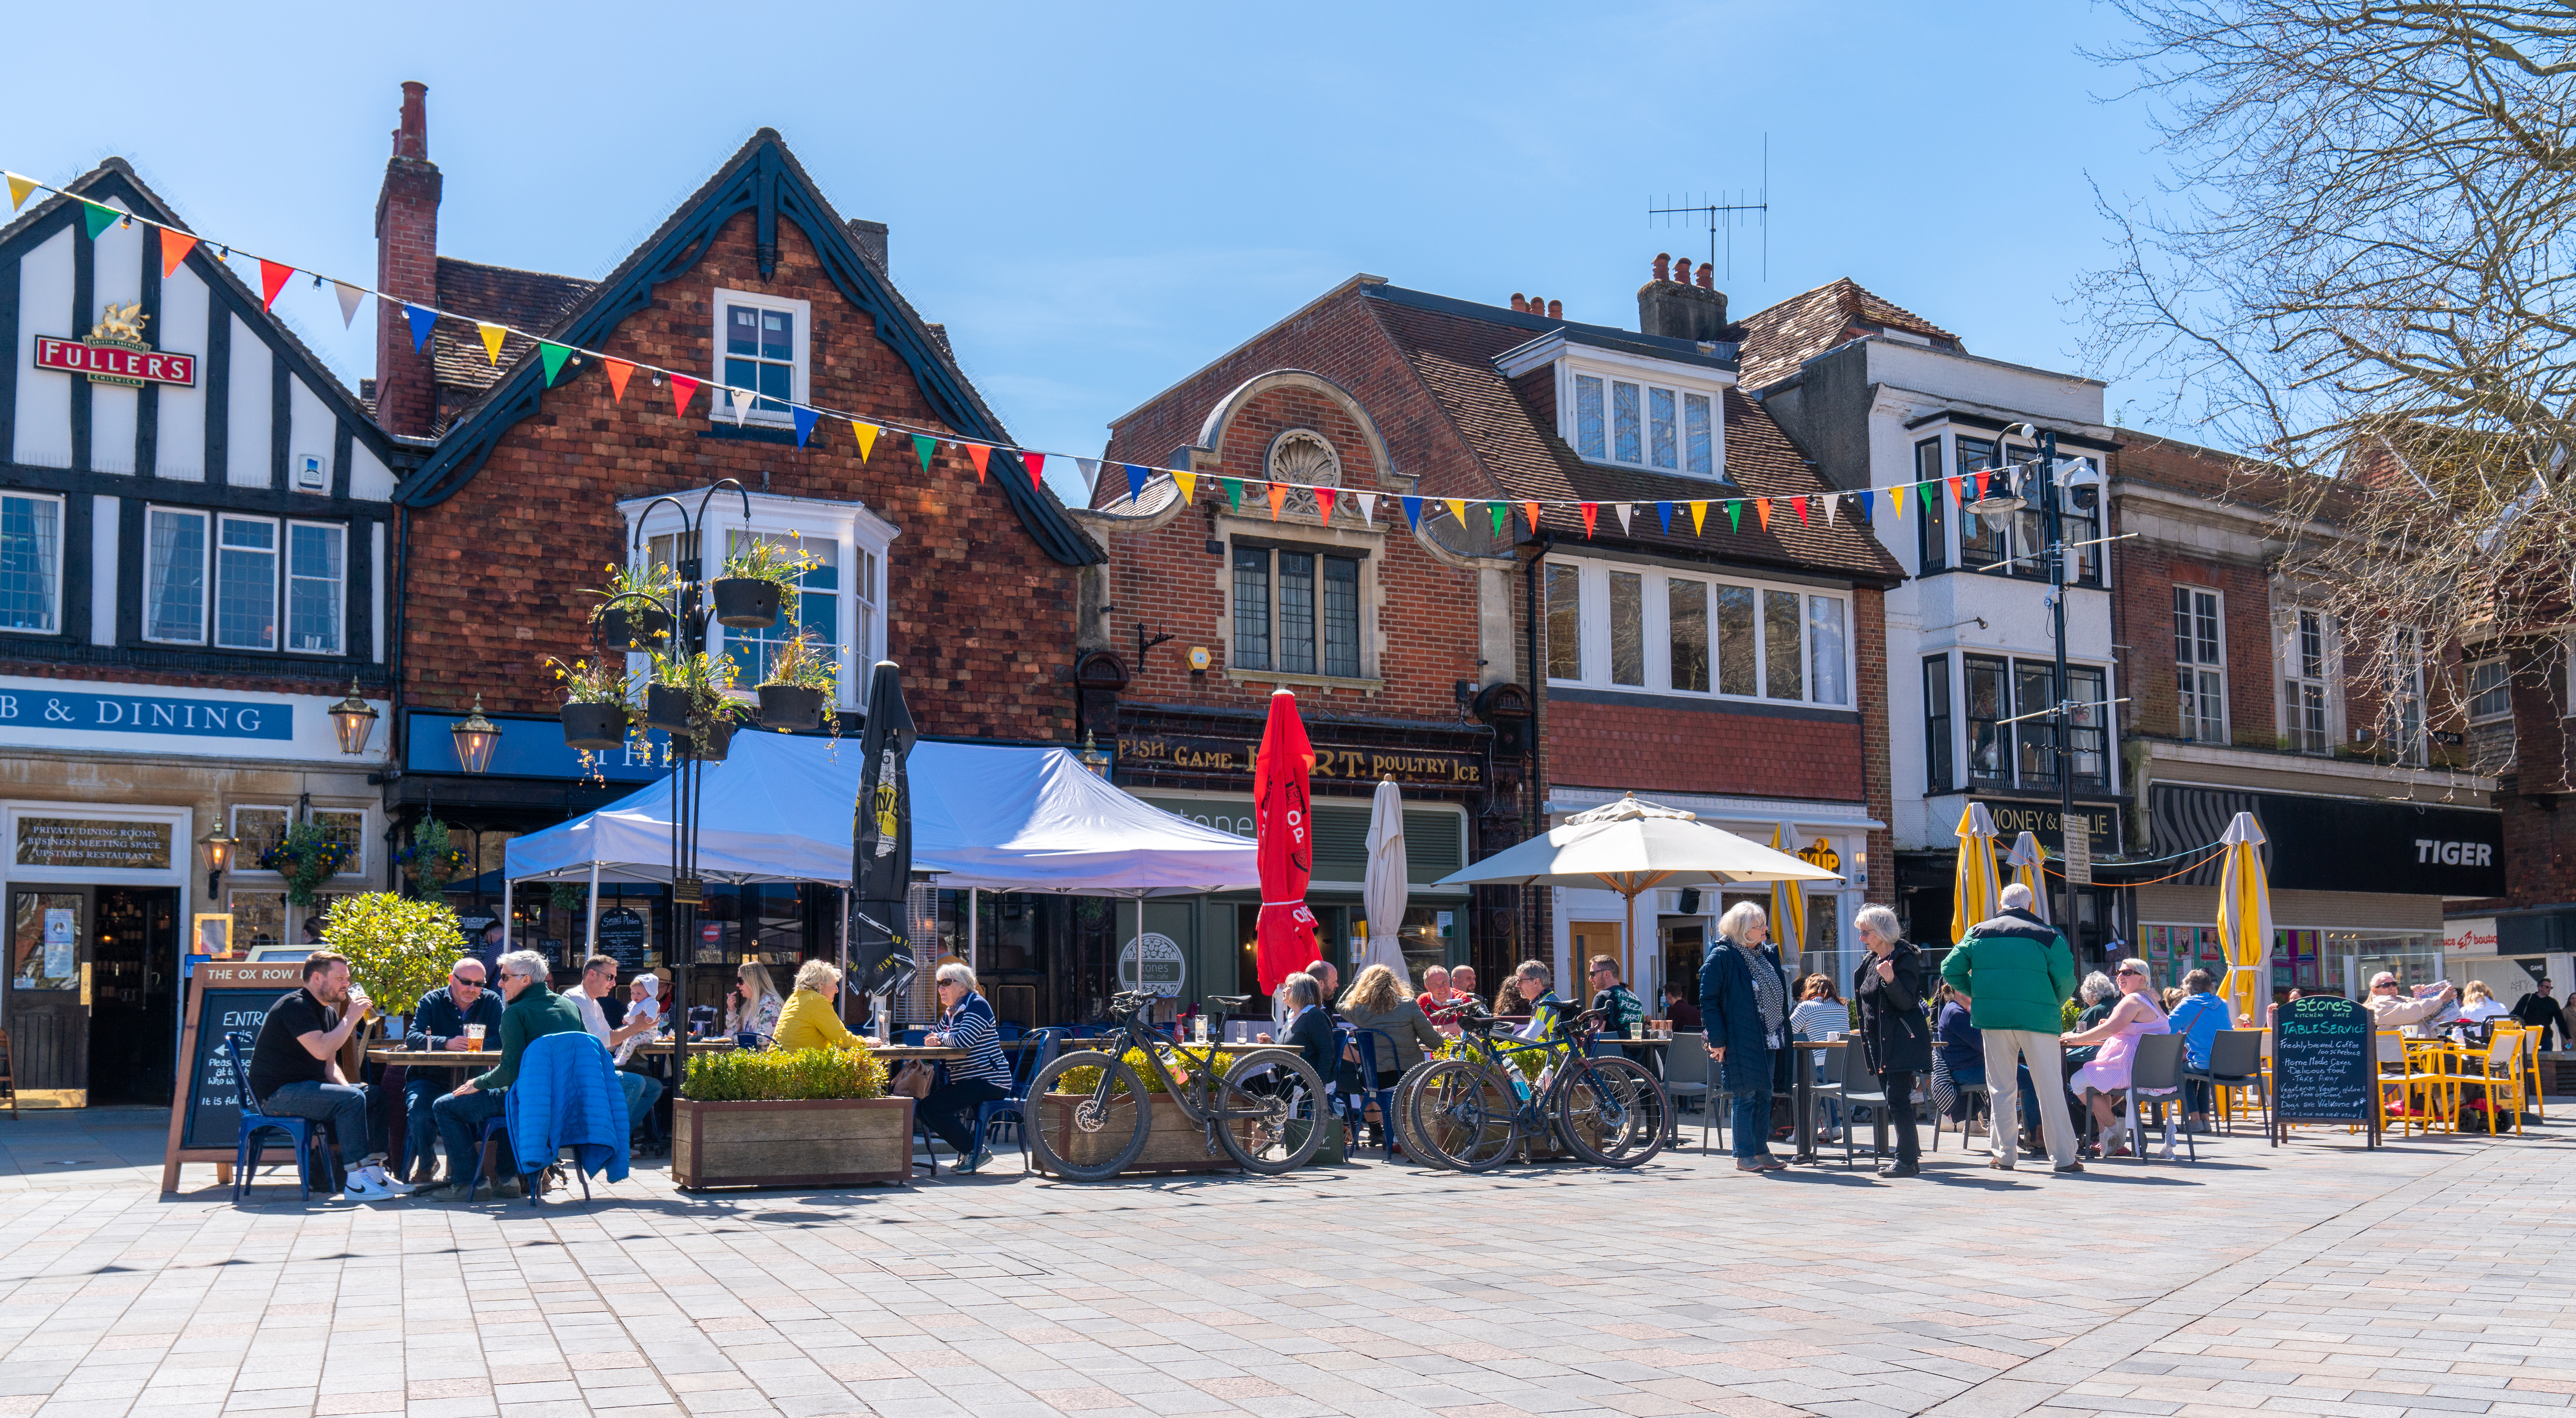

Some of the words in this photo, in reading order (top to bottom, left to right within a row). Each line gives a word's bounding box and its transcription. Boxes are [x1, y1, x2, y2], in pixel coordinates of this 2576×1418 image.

[45, 341, 184, 379] FULLER'S
[95, 374, 137, 384] CHISWICK
[44, 698, 75, 722] &
[96, 700, 261, 731] DINING
[1118, 739, 1165, 760] FISH
[1174, 746, 1232, 769] GAME
[1246, 745, 1365, 778] RT
[1372, 755, 1448, 778] POULTRY
[1453, 759, 1480, 781] ICE
[1986, 808, 2044, 831] MONEY
[2047, 813, 2057, 830] &
[33, 826, 76, 835] PRIVATE
[78, 828, 117, 836] DINING
[121, 830, 157, 838] ROOMS
[27, 837, 76, 846] BUSINESS
[79, 839, 127, 848] MEETING
[130, 841, 161, 849] SPACE
[35, 850, 84, 858] UPSTAIRS
[86, 851, 153, 860] RESTAURANT
[2415, 839, 2492, 866] TIGER
[602, 917, 622, 927] Small
[623, 916, 640, 925] Plates
[1141, 963, 1169, 972] tones
[208, 969, 233, 979] THE
[238, 969, 257, 979] OX
[262, 969, 295, 979] ROW
[1622, 1013, 1641, 1022] PART
[2281, 1021, 2319, 1034] TABLE
[2320, 1021, 2366, 1034] SERVICE
[2280, 1038, 2307, 1053] Freshly
[2308, 1040, 2334, 1048] brewed
[2336, 1040, 2359, 1048] Coffee
[208, 1058, 232, 1067] Pleas
[2284, 1058, 2307, 1066] Home
[2309, 1056, 2328, 1066] Made
[215, 1068, 226, 1077] at
[2289, 1066, 2325, 1074] Delicious
[2295, 1074, 2314, 1082] TAKE
[212, 1097, 222, 1106] is
[2281, 1100, 2300, 1110] Dogs
